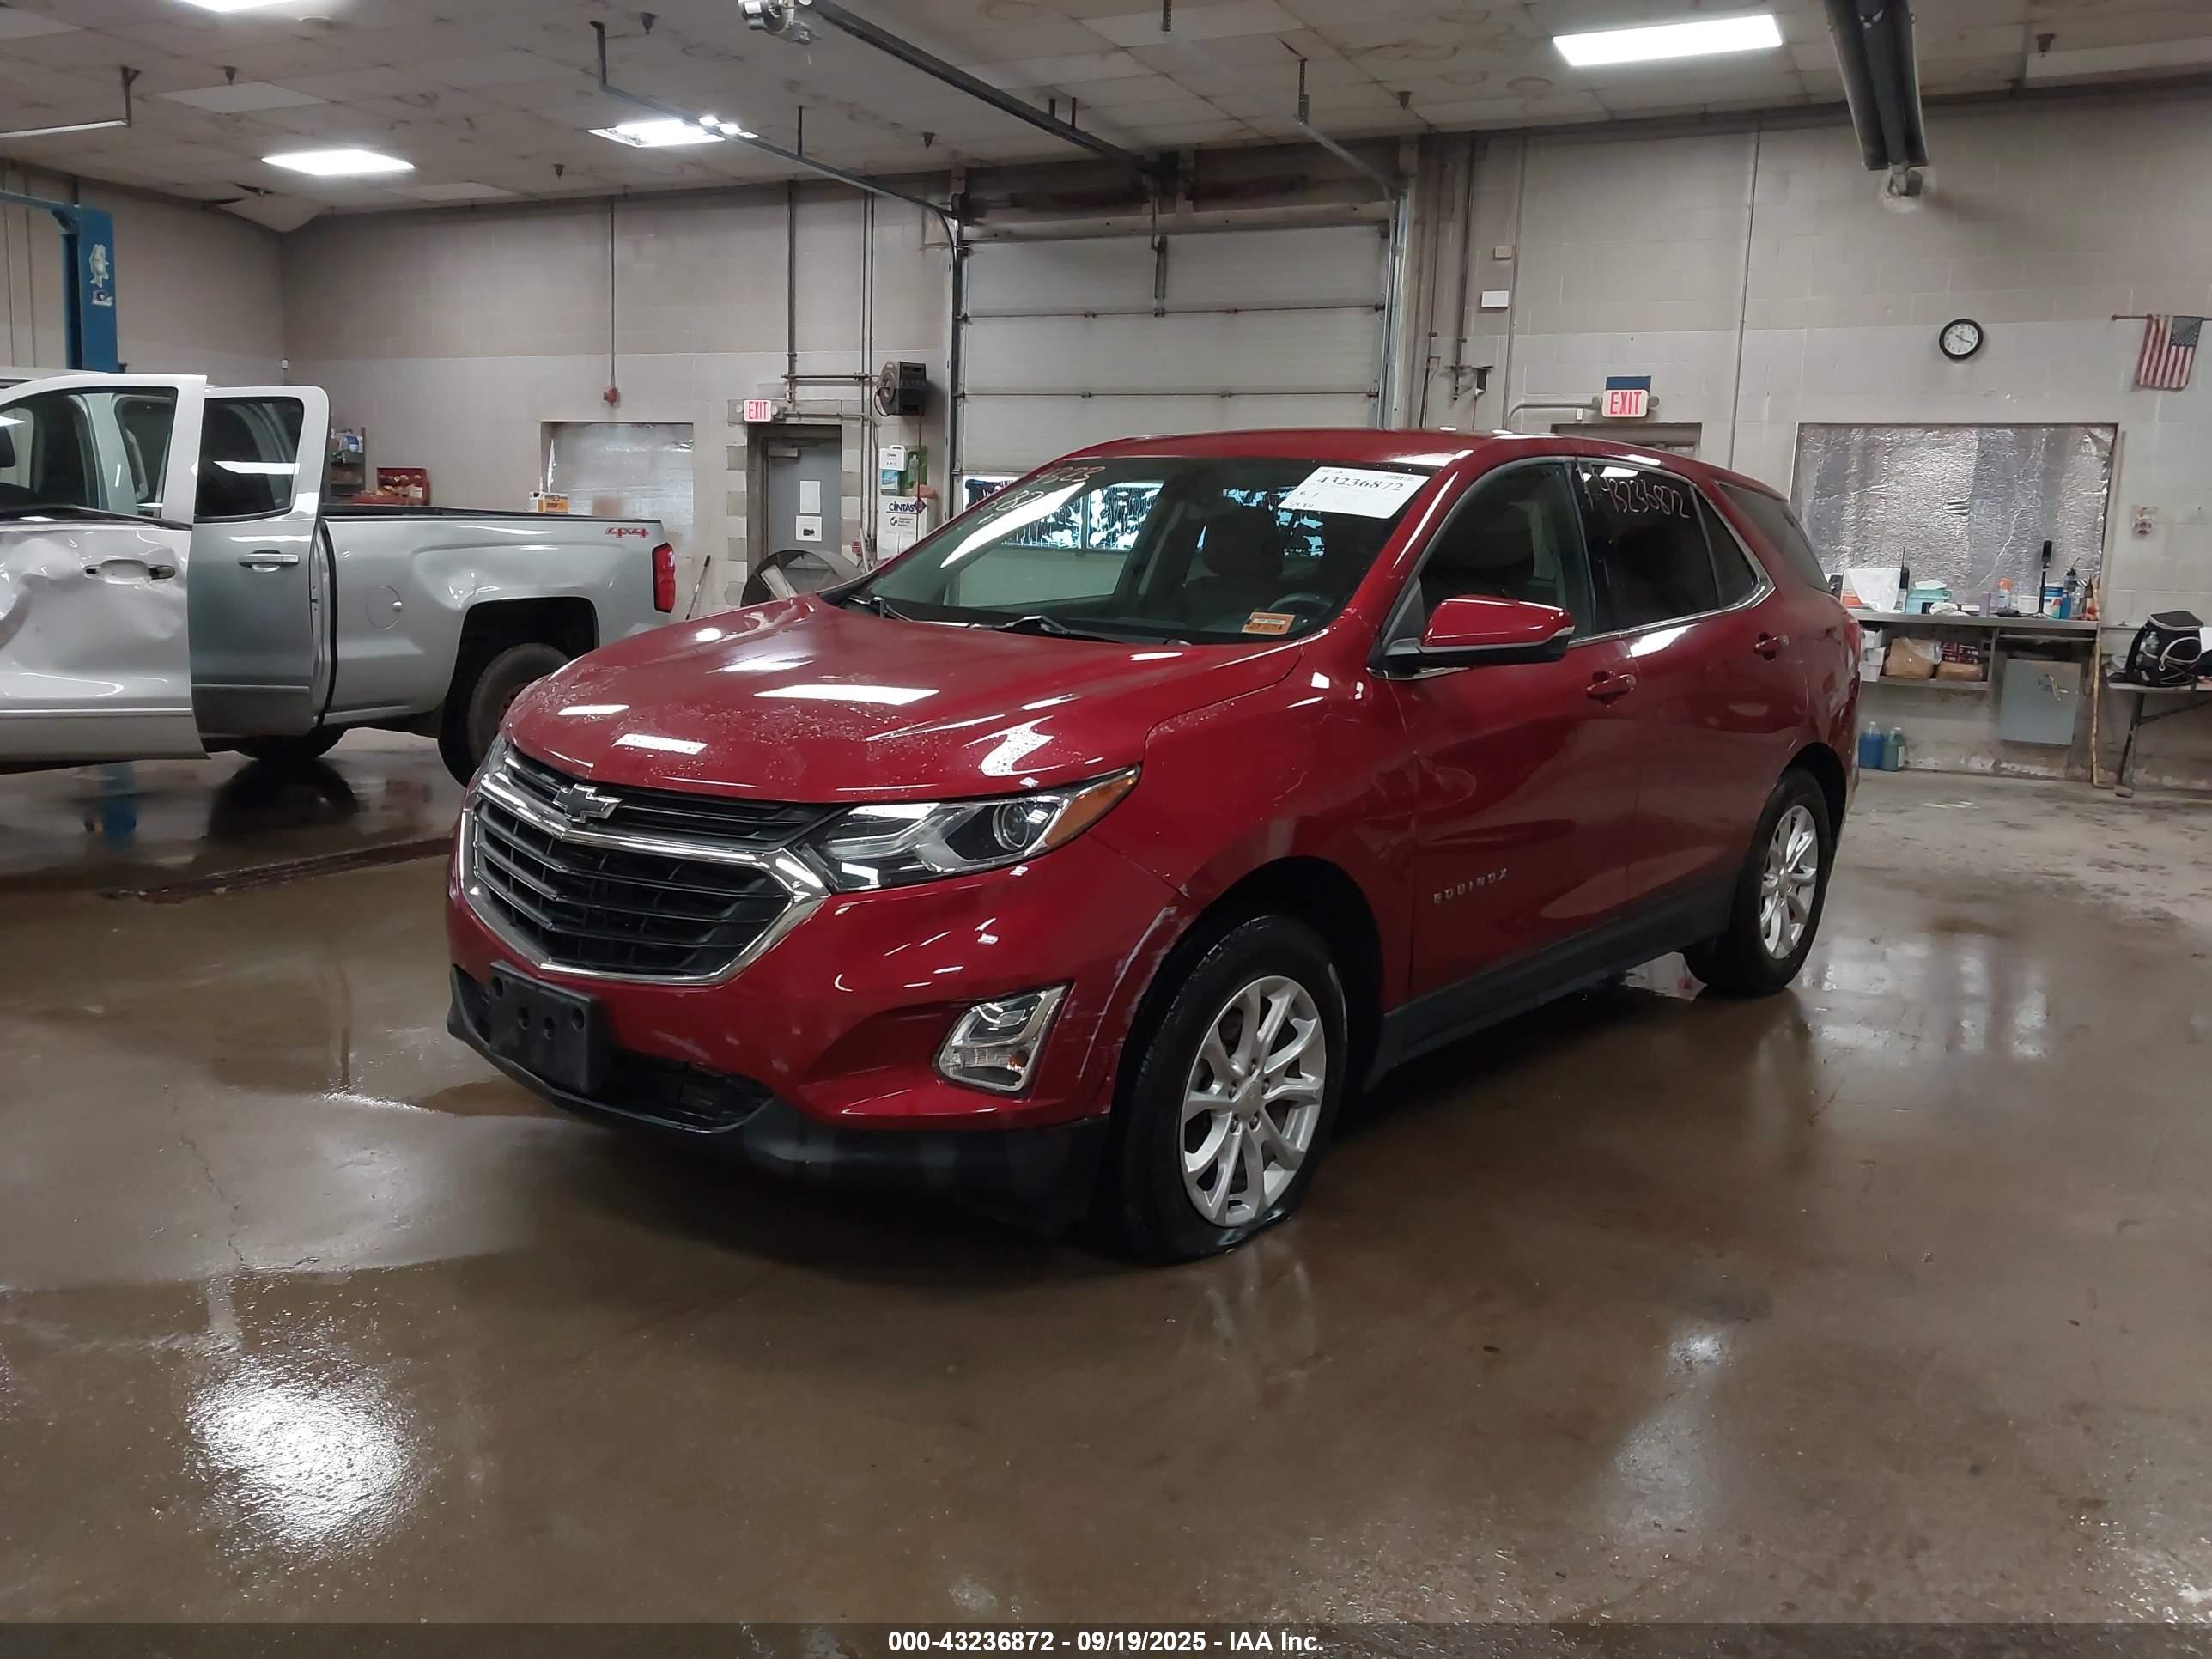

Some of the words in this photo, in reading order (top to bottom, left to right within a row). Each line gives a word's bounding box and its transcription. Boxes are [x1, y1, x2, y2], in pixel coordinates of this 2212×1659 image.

[749, 401, 768, 420] EXIT
[1610, 391, 1642, 415] EXIT
[1317, 475, 1404, 491] 43236872
[888, 501, 915, 513] CINTAS
[1433, 867, 1507, 904] EQUINOX
